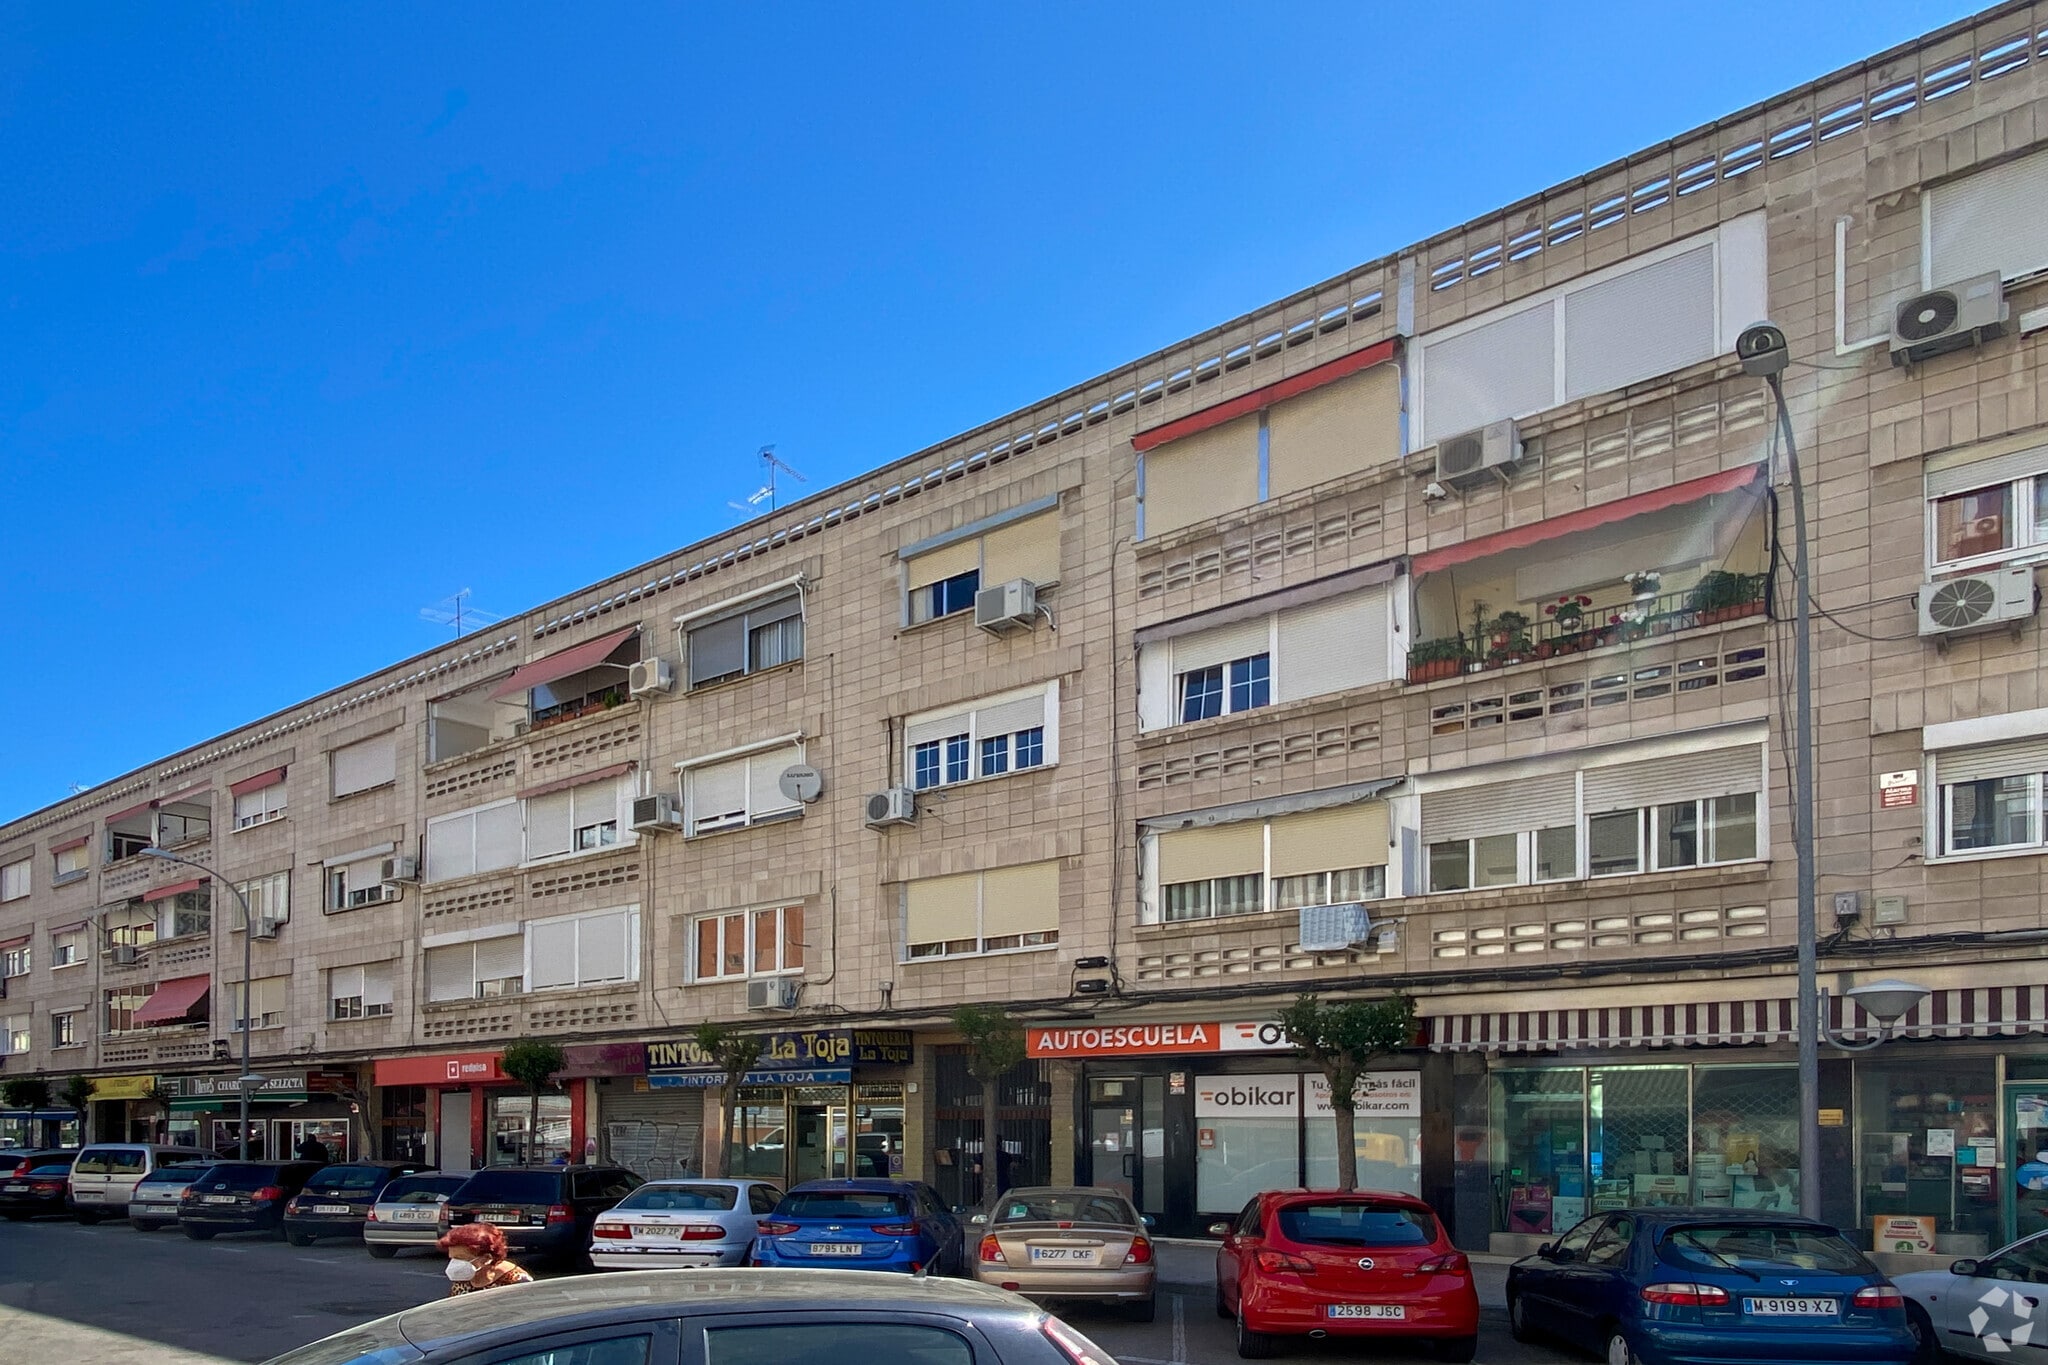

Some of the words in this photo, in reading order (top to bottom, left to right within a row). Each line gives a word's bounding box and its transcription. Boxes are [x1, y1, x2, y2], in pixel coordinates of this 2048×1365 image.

[1037, 1024, 1208, 1050] AUTOESCUELA
[770, 1036, 797, 1060] La
[801, 1033, 850, 1063] Toja
[757, 1073, 774, 1083] LA
[780, 1073, 815, 1083] TOJA
[1311, 1080, 1323, 1090] Tu
[1391, 1078, 1416, 1089] fácil
[1215, 1086, 1296, 1106] obikar
[646, 1227, 666, 1236] 2027
[1041, 1249, 1066, 1259] 6277
[1072, 1249, 1092, 1259] CKF
[1337, 1305, 1371, 1317] 2598
[1377, 1306, 1402, 1317] JSC
